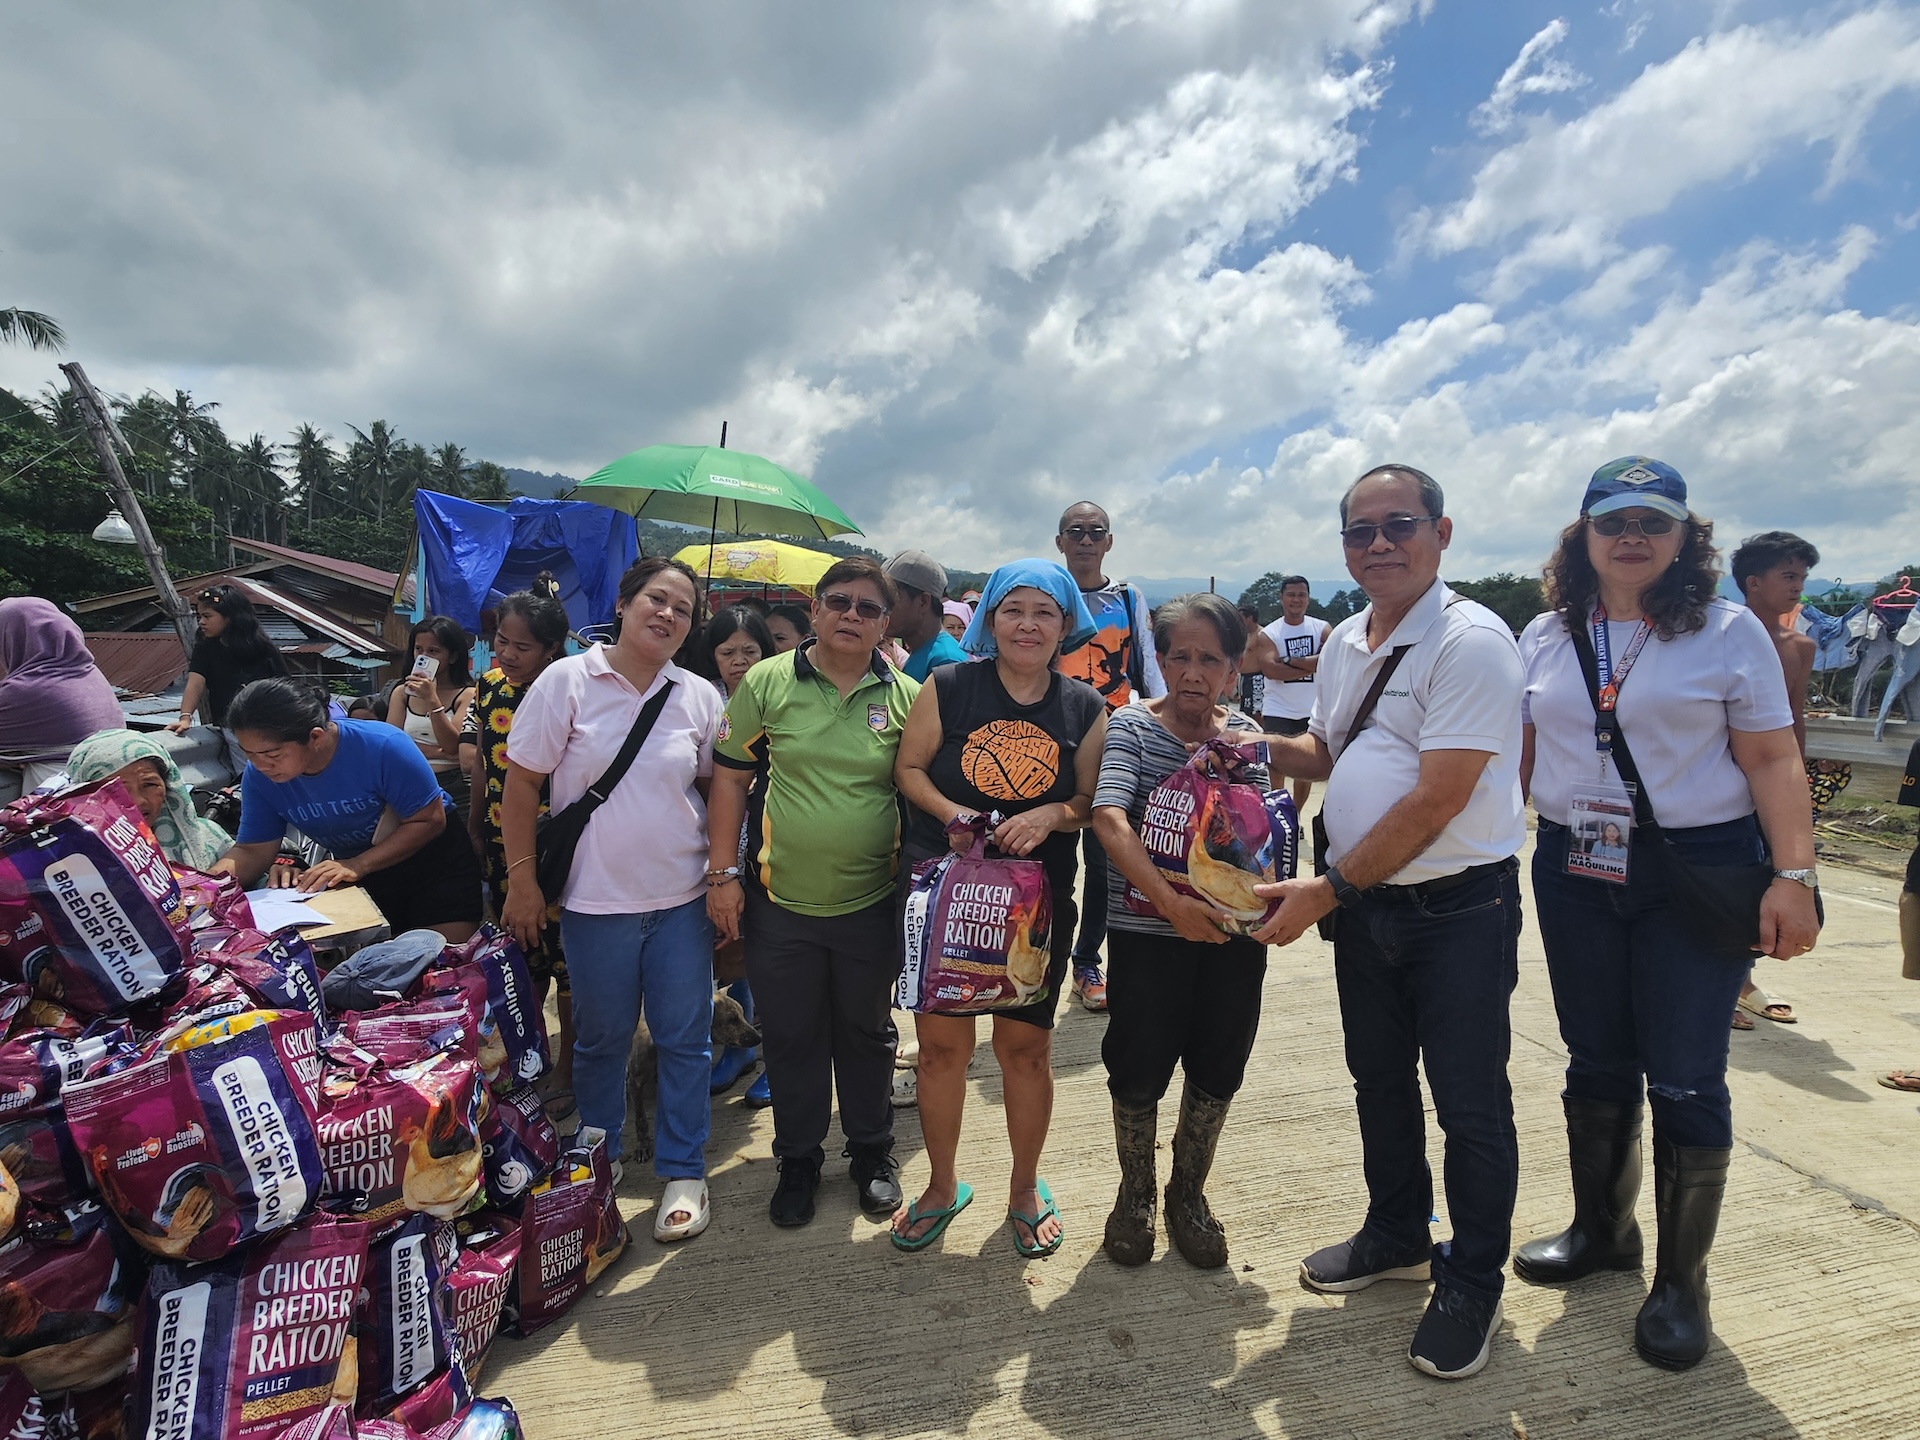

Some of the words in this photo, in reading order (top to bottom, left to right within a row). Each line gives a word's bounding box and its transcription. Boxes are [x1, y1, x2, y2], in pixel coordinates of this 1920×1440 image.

[711, 476, 738, 485] CARD
[1569, 859, 1625, 875] MAQUILING
[951, 882, 1013, 906] CHICKEN
[90, 891, 143, 957] CHICKEN
[947, 902, 1009, 926] BREEDER
[52, 869, 105, 939] BREEDER
[96, 938, 145, 996] RATION
[943, 921, 1006, 951] RATION
[942, 947, 969, 958] PELLET
[500, 962, 525, 1038] Gallimax
[176, 1130, 191, 1140] Egg
[257, 1101, 298, 1181] CHICKEN
[317, 1105, 394, 1145] HICKEN
[117, 1153, 149, 1170] ProTech
[126, 1146, 146, 1159] Liver
[166, 1137, 200, 1154] Booster
[221, 1072, 265, 1157] BREEDER
[255, 1156, 281, 1225] RATION
[321, 1134, 393, 1169] REEDER
[322, 1158, 394, 1196] ATION
[541, 1228, 583, 1254] CHICKEN
[541, 1240, 582, 1267] BREEDER
[257, 1254, 360, 1296] CHICKEN
[541, 1251, 582, 1281] RATION
[397, 1246, 413, 1326] BREEDER
[252, 1289, 353, 1331] BREEDER
[415, 1276, 429, 1350] CHICKEN
[157, 1296, 183, 1403] BREEDER
[248, 1320, 350, 1375] RATION
[399, 1326, 413, 1389] RATION
[171, 1338, 196, 1440] CHICKEN
[247, 1376, 291, 1397] PELLET
[239, 1426, 252, 1436] Net
